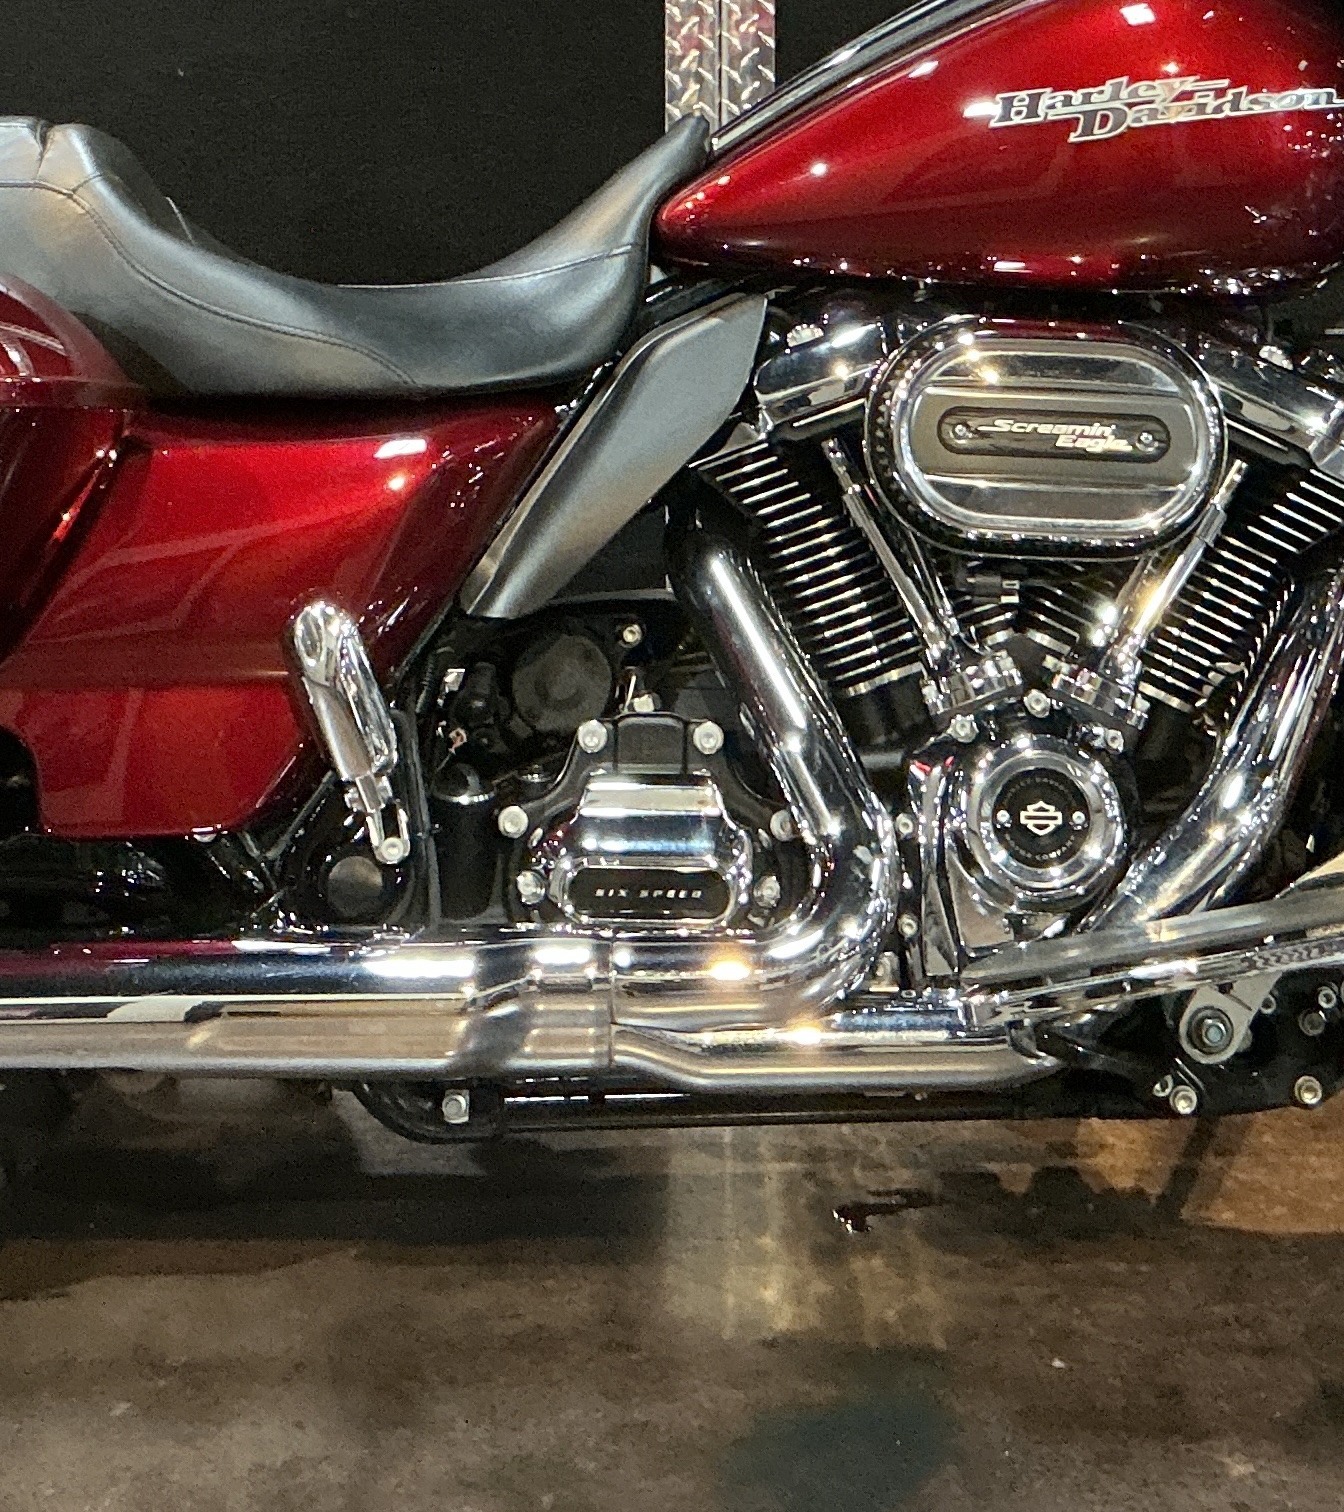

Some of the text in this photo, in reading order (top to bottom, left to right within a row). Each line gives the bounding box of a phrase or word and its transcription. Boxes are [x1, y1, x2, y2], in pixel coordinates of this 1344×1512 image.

[1055, 434, 1133, 453] Eagle
[595, 888, 702, 899] SIX SPEED
